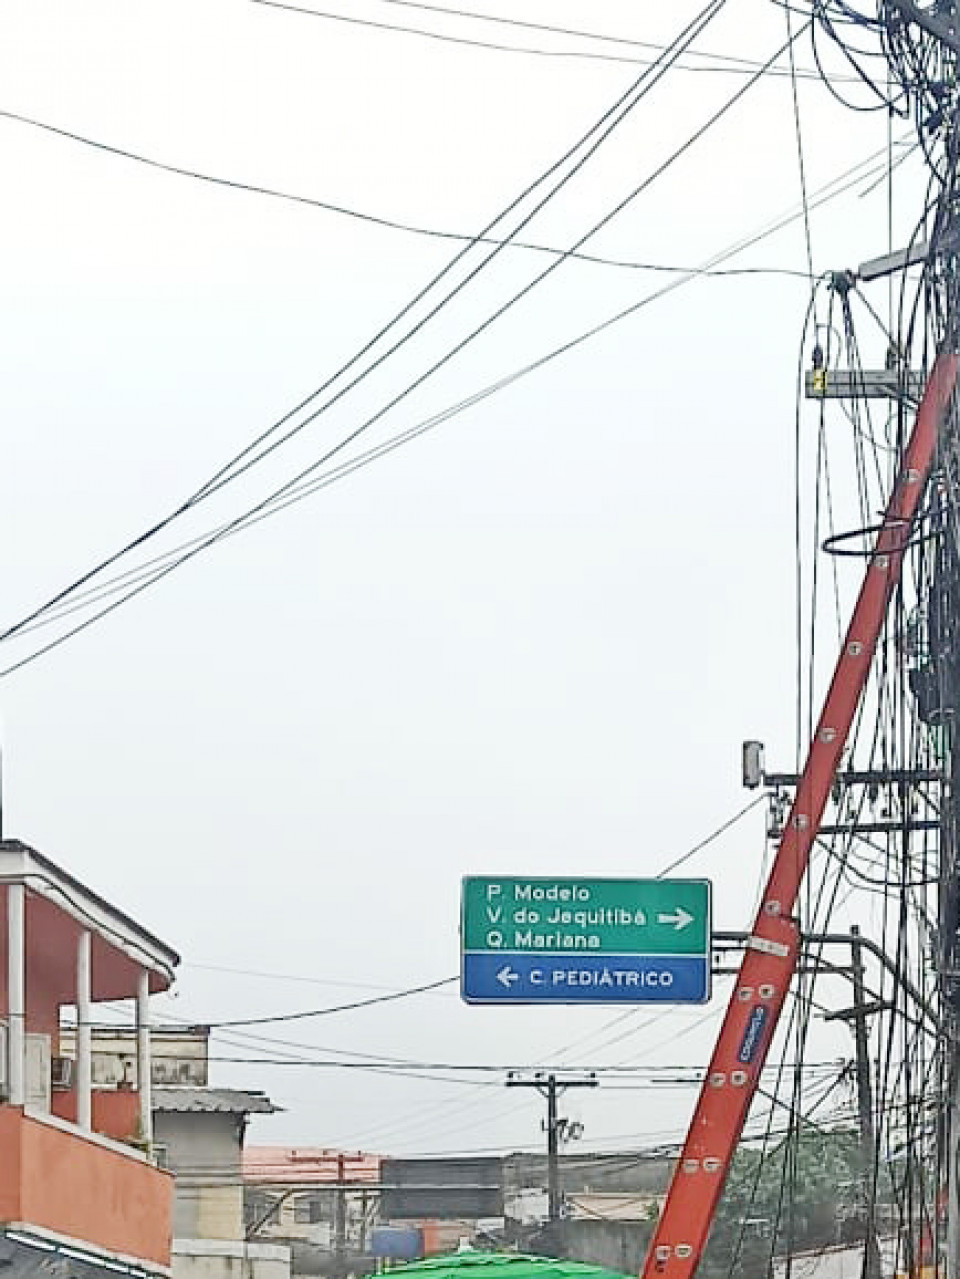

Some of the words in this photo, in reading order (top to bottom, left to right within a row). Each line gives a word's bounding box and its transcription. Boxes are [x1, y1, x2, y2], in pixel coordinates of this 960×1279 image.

[514, 884, 590, 901] Modelo
[513, 906, 540, 924] do
[486, 930, 507, 948] Q.
[514, 930, 601, 948] Mariana
[552, 967, 673, 987] PEDIÁTRICO
